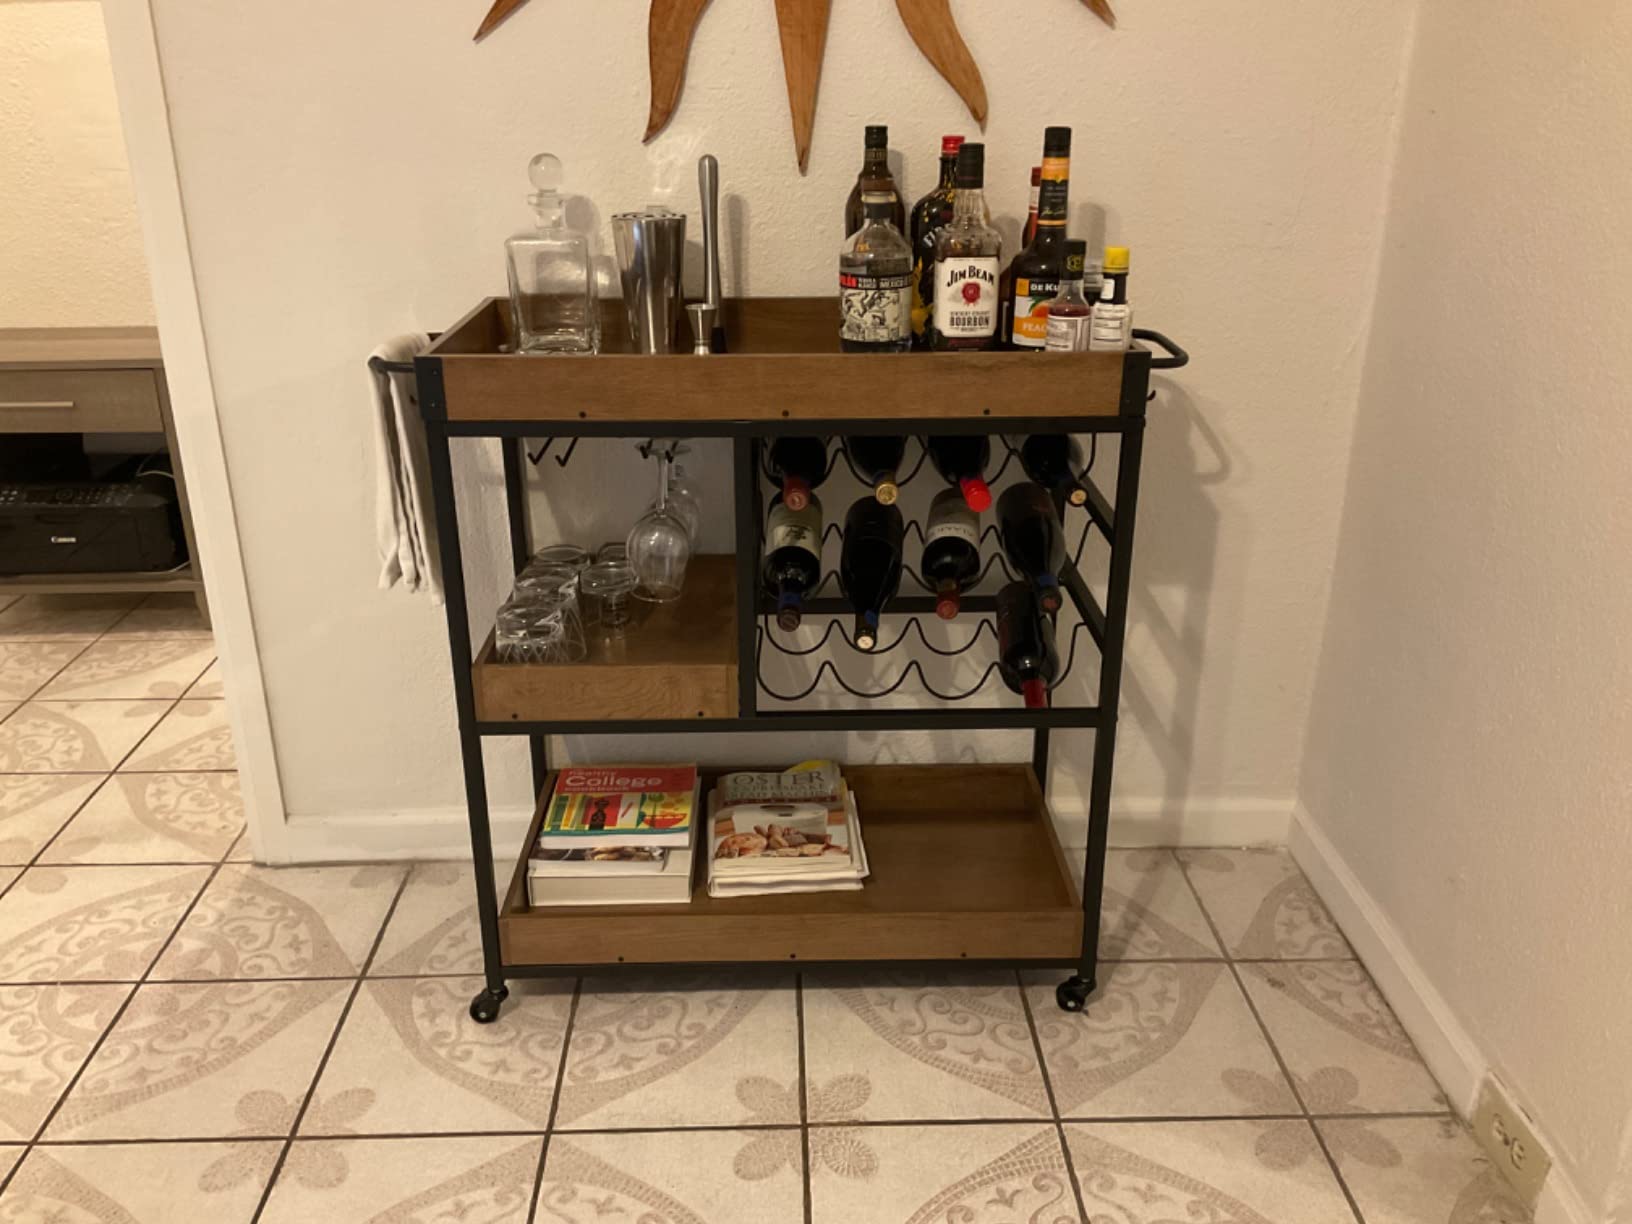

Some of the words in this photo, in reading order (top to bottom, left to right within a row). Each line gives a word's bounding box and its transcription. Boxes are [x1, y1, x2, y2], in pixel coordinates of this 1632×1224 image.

[946, 269, 966, 288] JIM
[968, 265, 995, 286] BEAM
[1030, 283, 1044, 291] DE
[950, 316, 990, 327] BOURBON
[1023, 322, 1047, 332] PEAC
[565, 775, 663, 789] College
[733, 770, 825, 786] OSTER
